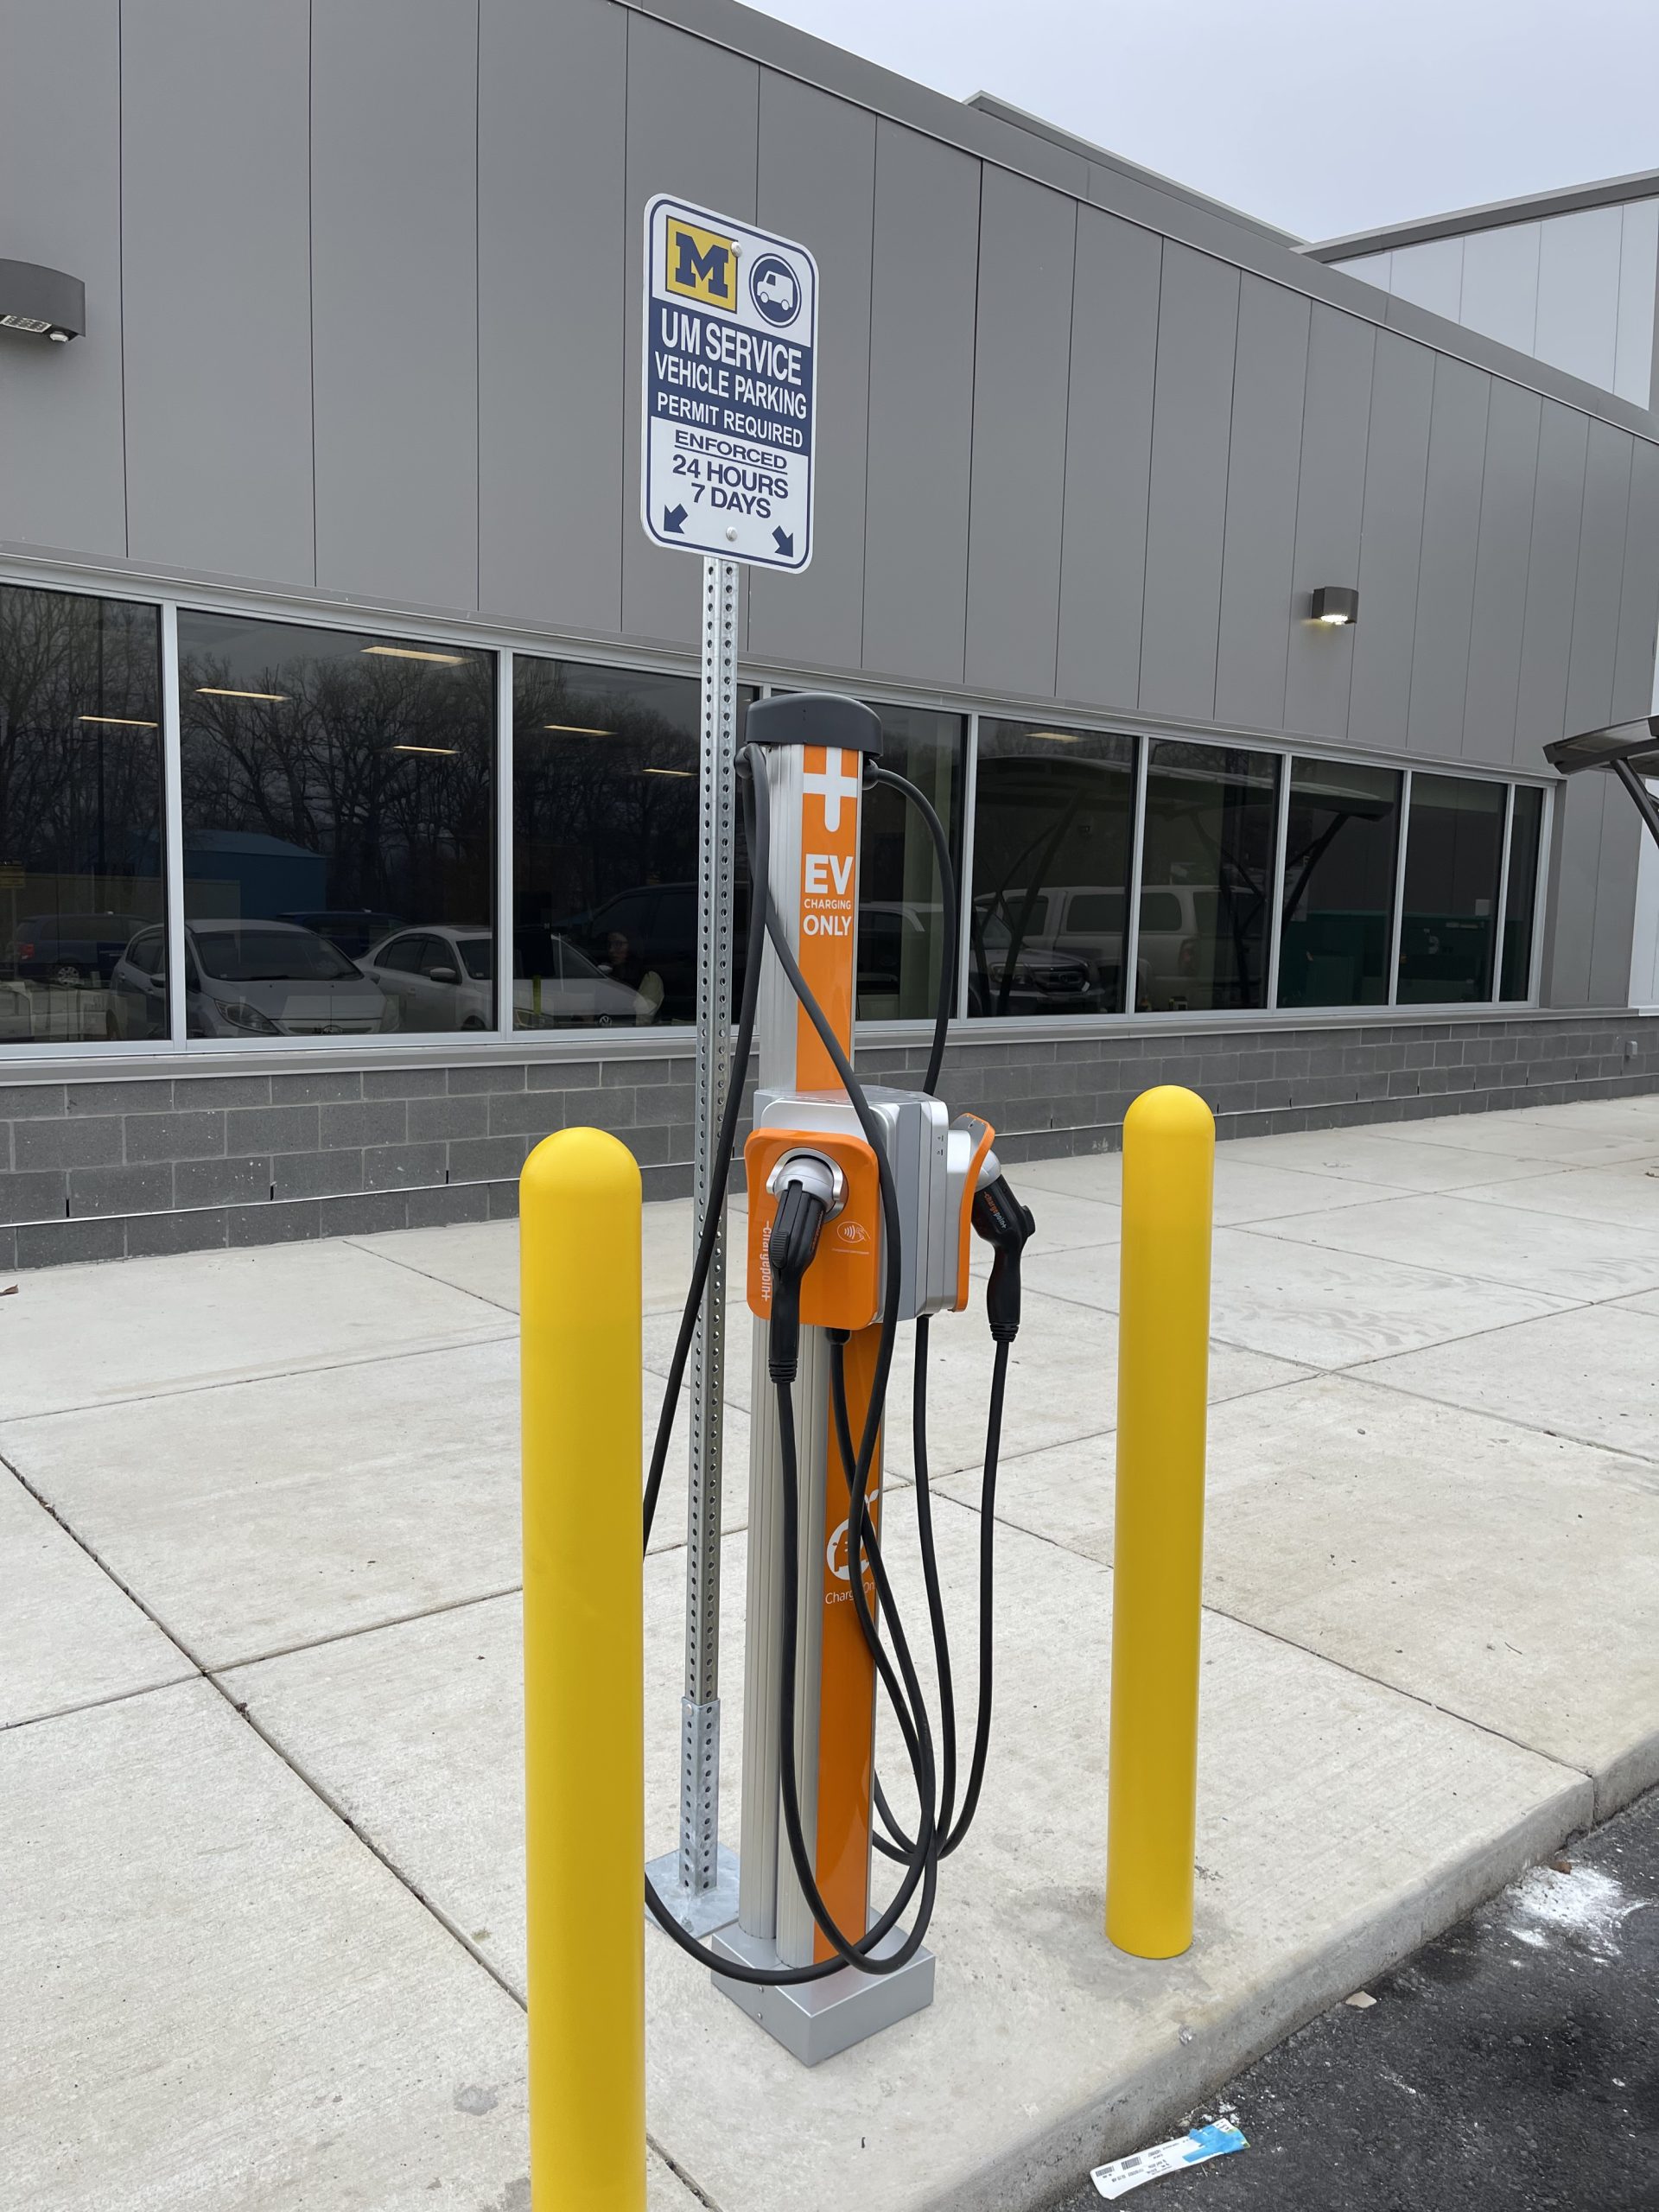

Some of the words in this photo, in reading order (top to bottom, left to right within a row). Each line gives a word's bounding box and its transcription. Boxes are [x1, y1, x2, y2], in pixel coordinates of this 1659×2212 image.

[675, 231, 729, 299] M
[660, 308, 701, 355] UM
[705, 323, 803, 385] SERVICE
[655, 351, 729, 398] VEHICLE
[734, 373, 807, 420] PARKING
[657, 391, 719, 427] PERMIT
[723, 409, 804, 448] REQUIRED
[674, 429, 788, 469] ENFORCED
[672, 454, 701, 479] 24
[706, 462, 789, 499] HOURS
[690, 483, 705, 503] 7
[710, 486, 772, 519] DAYS
[804, 854, 854, 894] EV
[803, 914, 852, 936] ONLY
[804, 898, 851, 910] CHARGING
